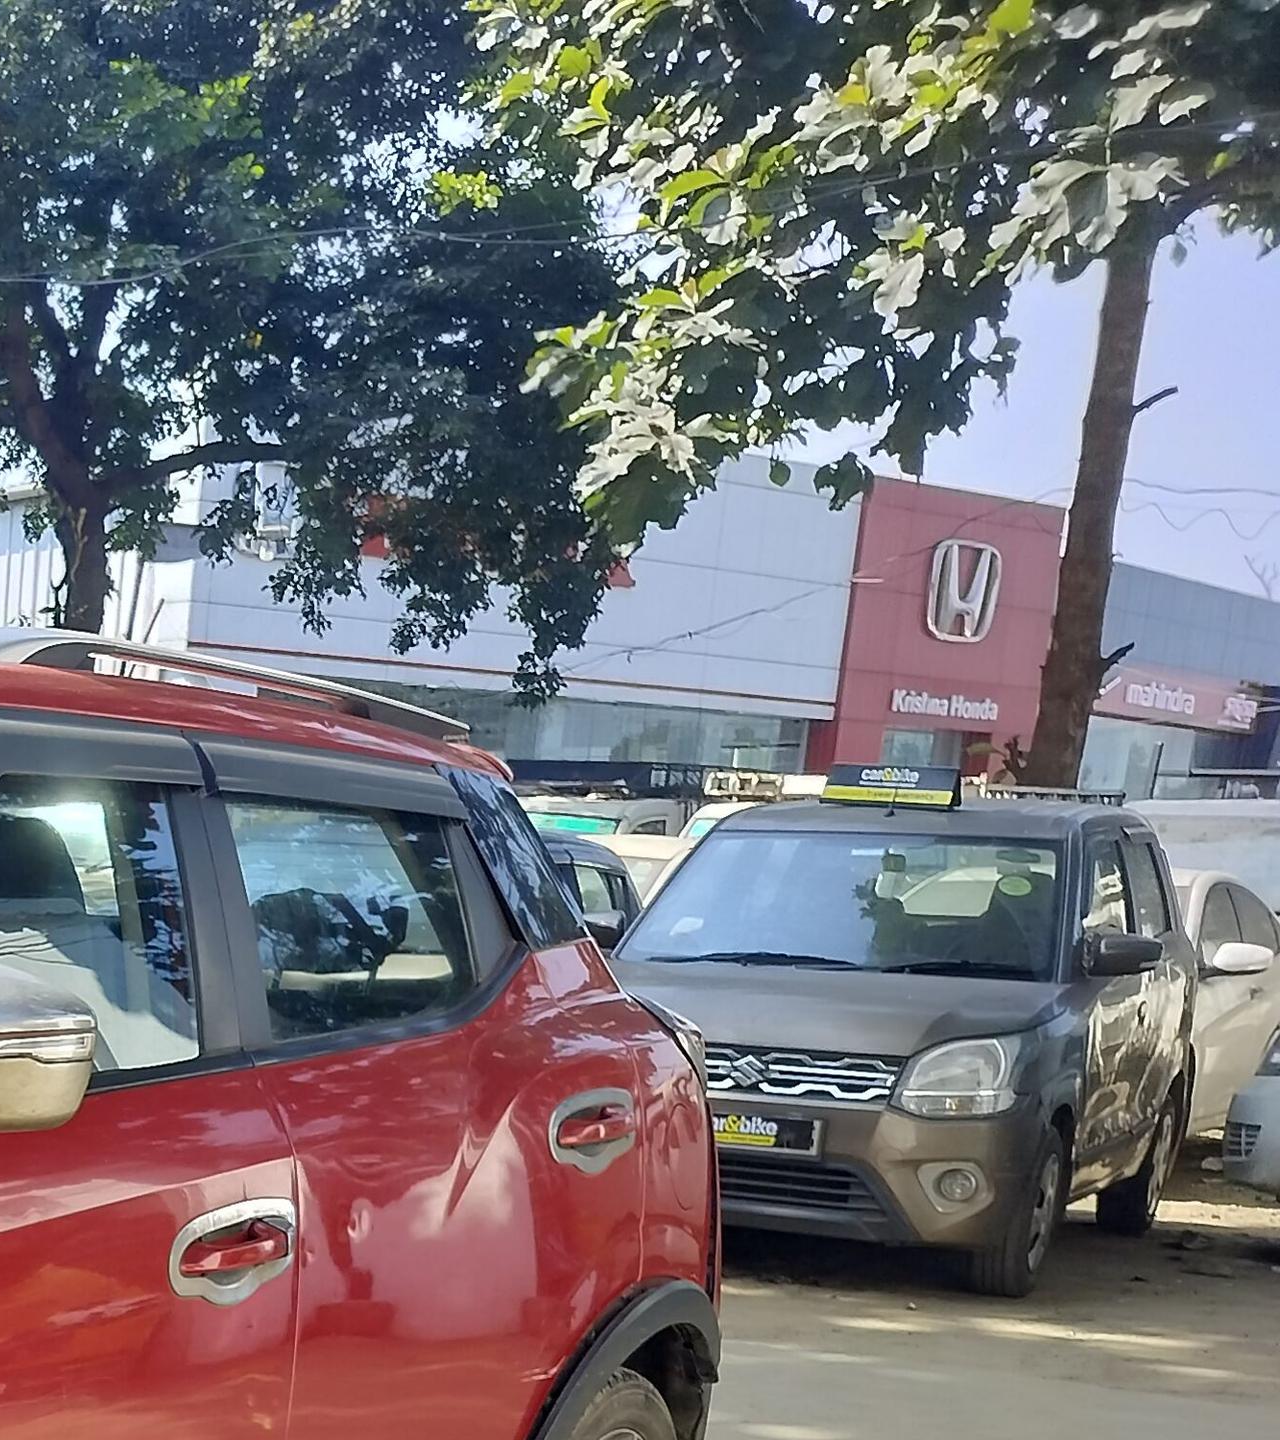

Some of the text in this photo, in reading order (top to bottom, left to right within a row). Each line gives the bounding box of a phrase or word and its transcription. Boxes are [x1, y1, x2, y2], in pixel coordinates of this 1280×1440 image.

[891, 688, 998, 720] Krishna Honda
[1125, 682, 1195, 715] mahindra
[861, 767, 919, 783] car&bike
[712, 1115, 778, 1136] ar&bike
